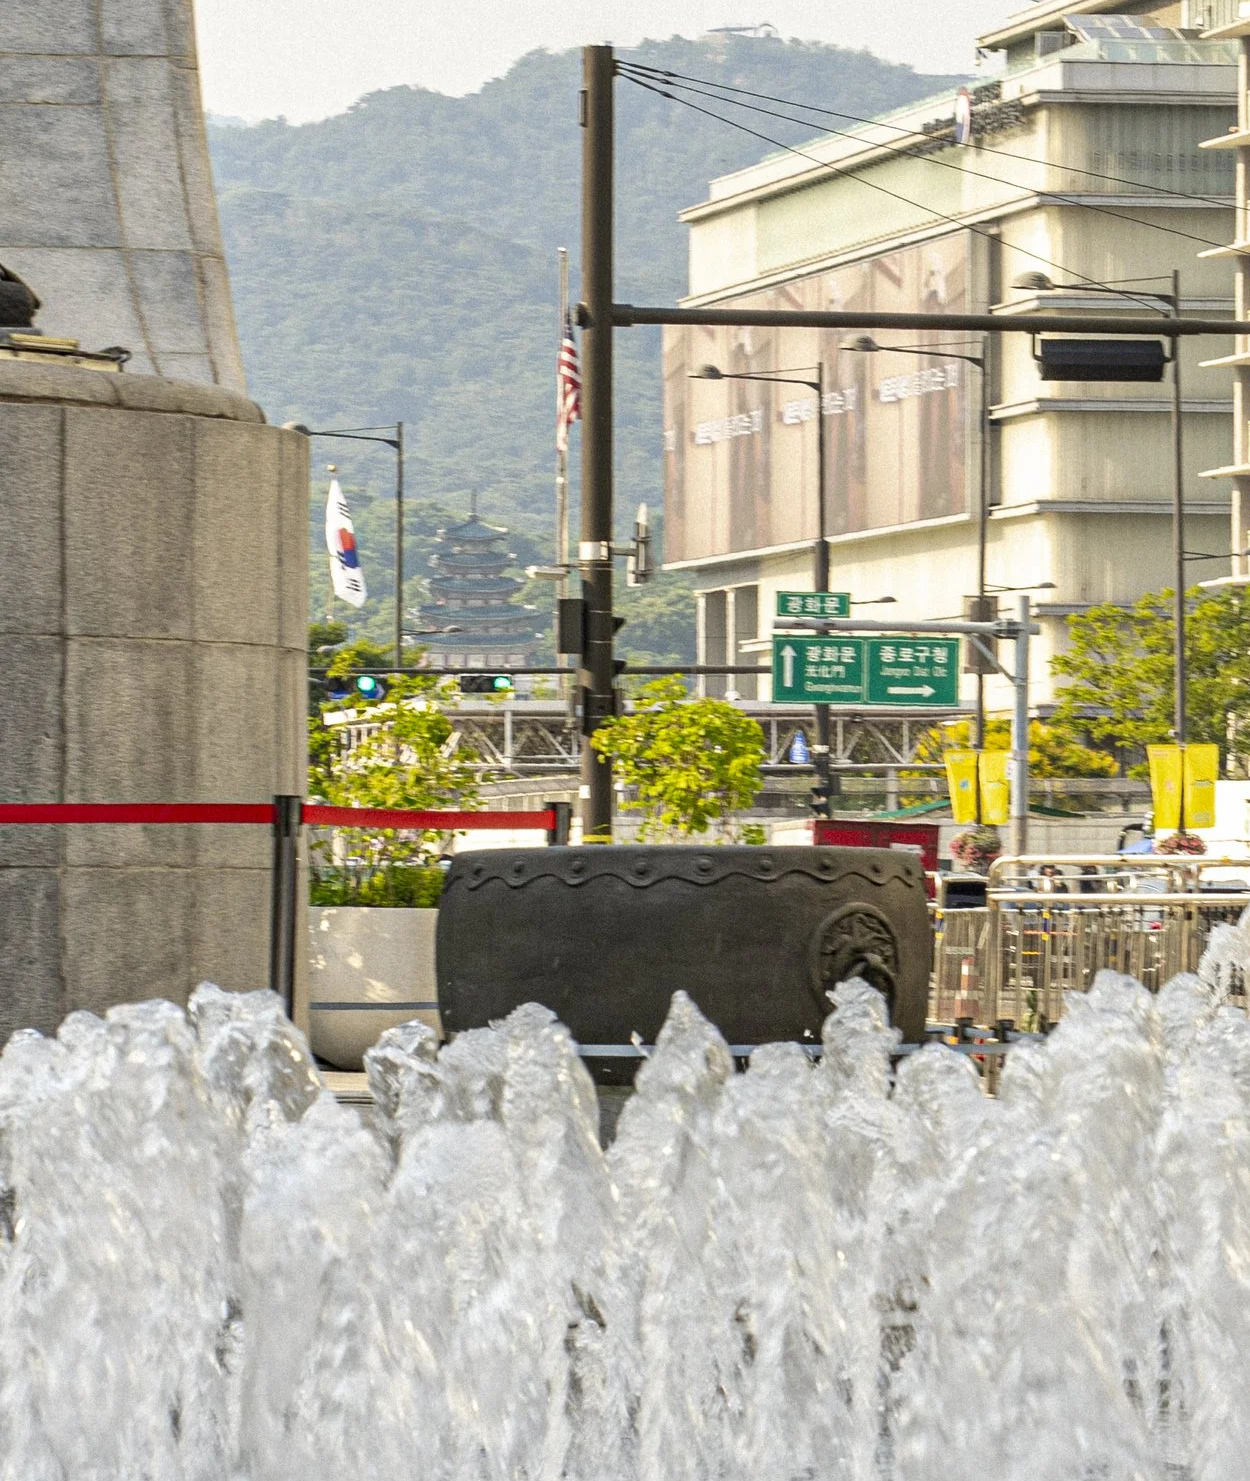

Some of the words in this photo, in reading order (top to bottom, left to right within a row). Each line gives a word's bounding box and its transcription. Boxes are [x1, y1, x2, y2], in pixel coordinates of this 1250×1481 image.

[786, 596, 841, 614] 광화문
[805, 646, 857, 663] 광화문
[879, 645, 949, 664] 종로구청
